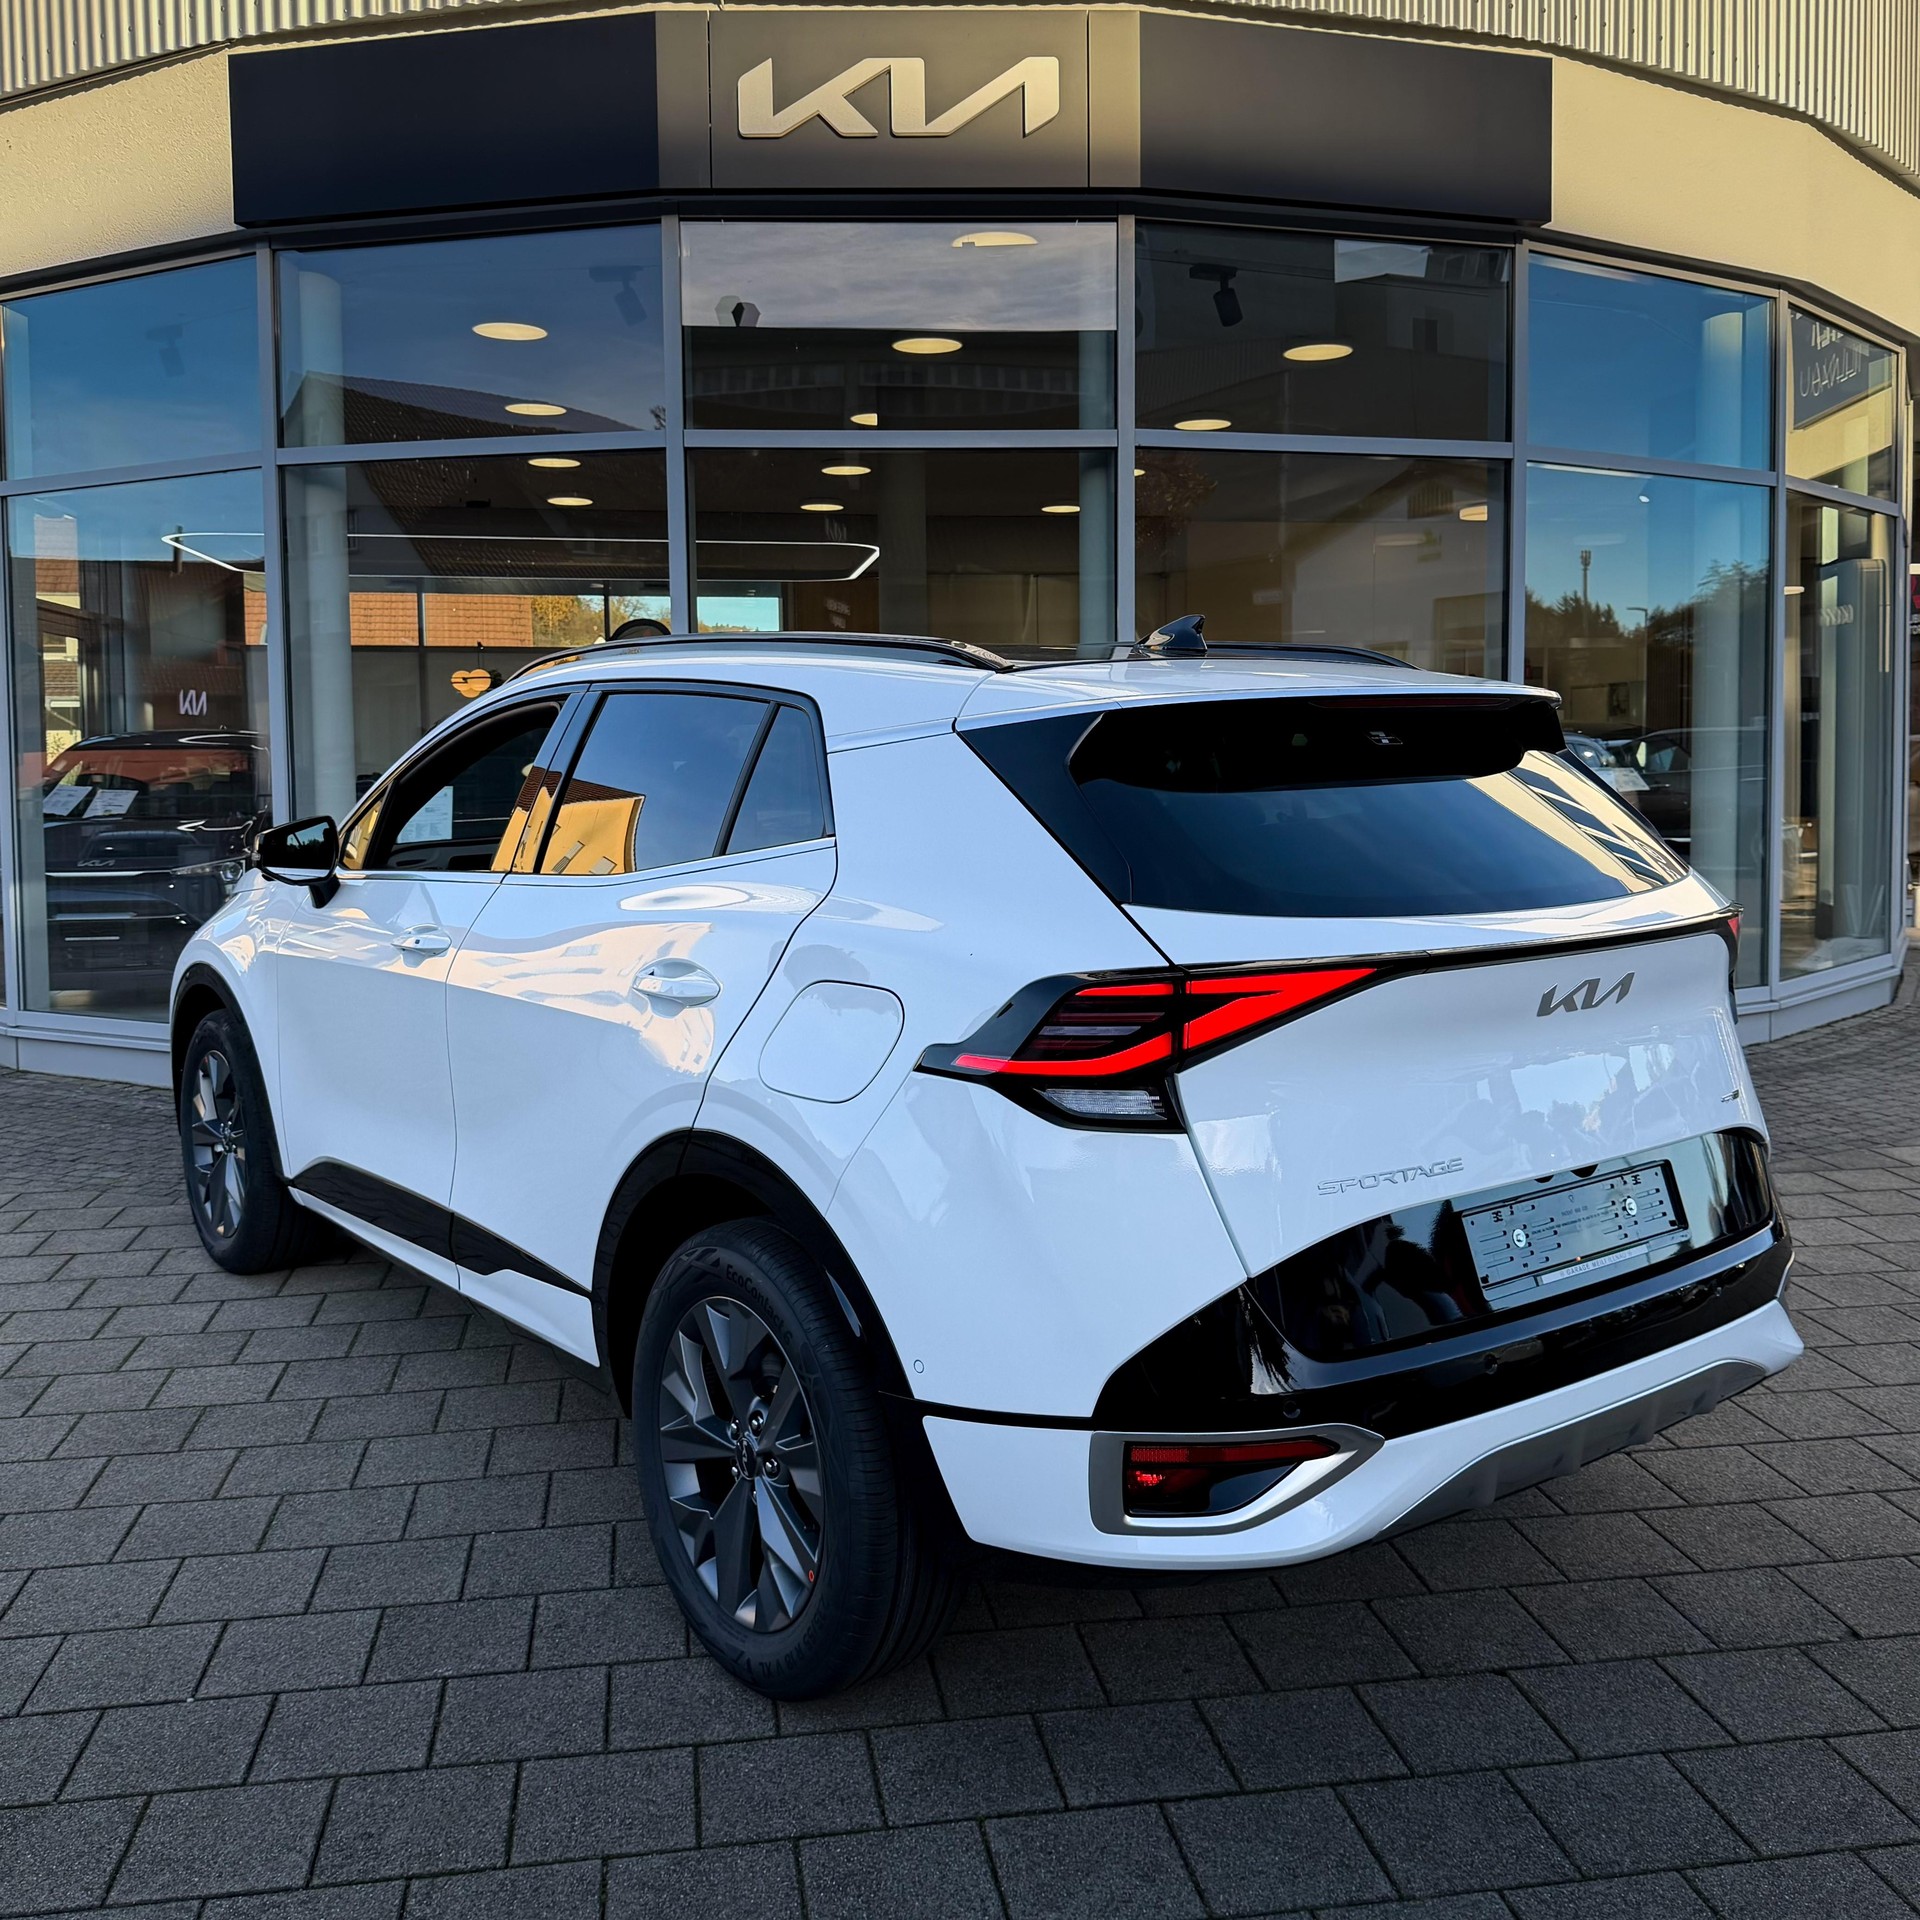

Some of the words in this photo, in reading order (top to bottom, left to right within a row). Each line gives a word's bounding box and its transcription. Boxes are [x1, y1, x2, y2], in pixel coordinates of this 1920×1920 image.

[737, 55, 1060, 138] KIA
[178, 688, 208, 717] KIA
[1536, 971, 1636, 1017] KIA
[1317, 1157, 1465, 1196] SPORTAGE
[1566, 1263, 1591, 1276] GARAGE
[726, 1263, 786, 1334] EcoContact
